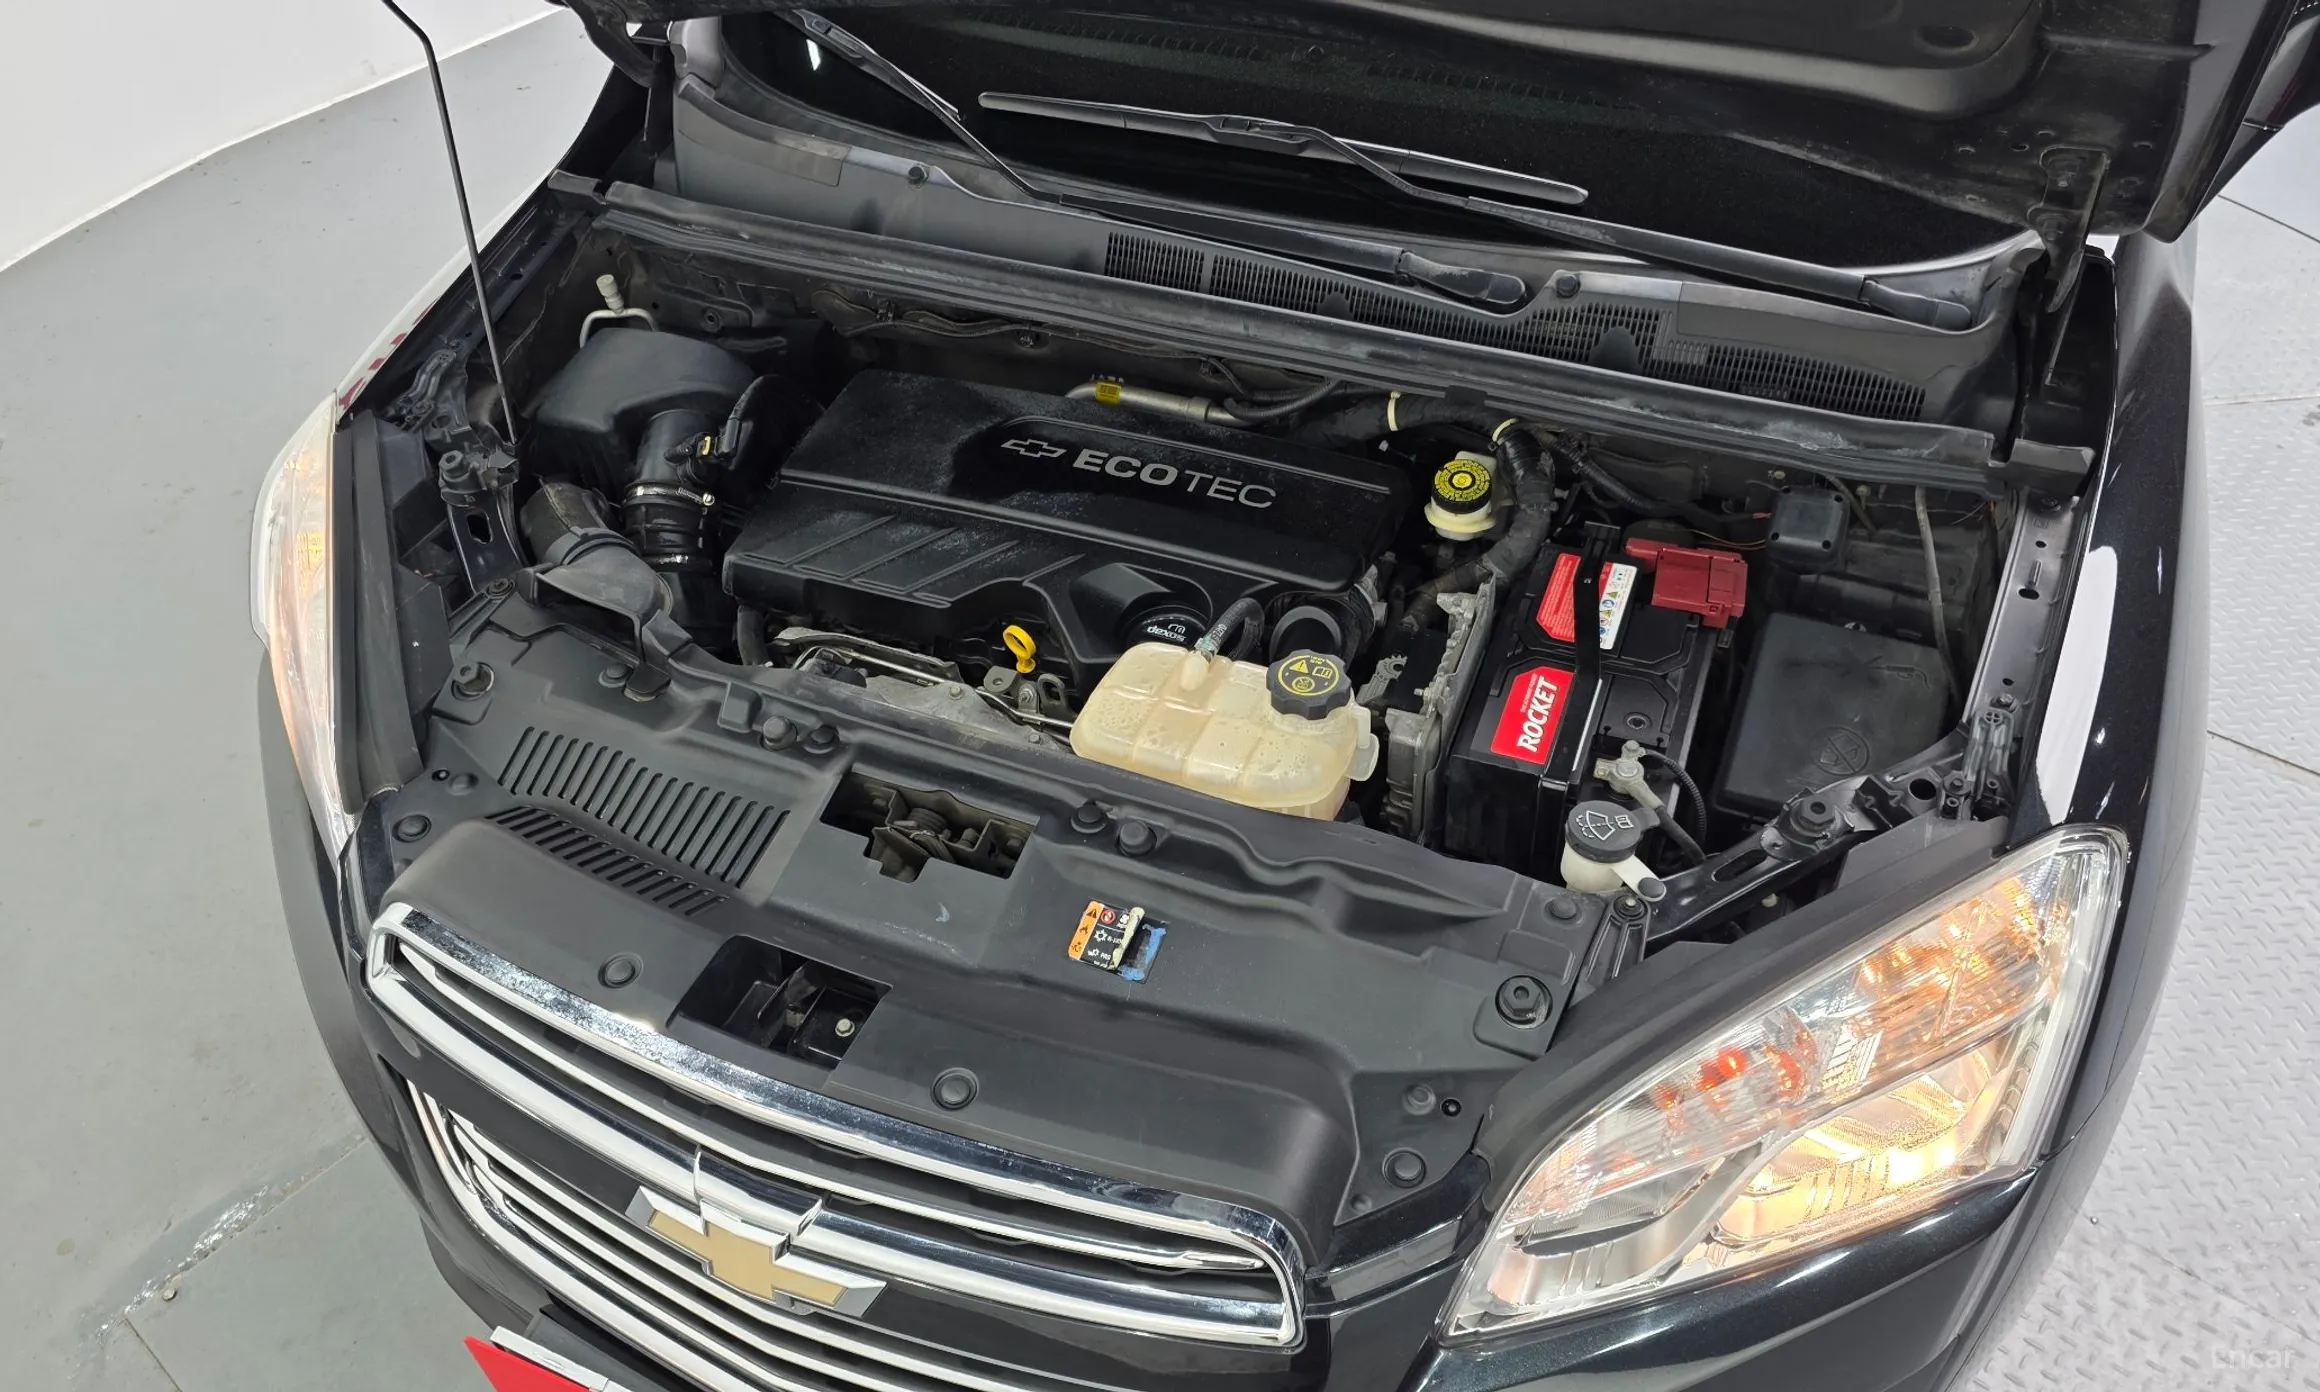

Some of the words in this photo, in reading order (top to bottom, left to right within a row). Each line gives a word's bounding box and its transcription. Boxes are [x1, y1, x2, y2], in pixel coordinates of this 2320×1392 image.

[1073, 448, 1277, 509] ECOTEC
[1146, 625, 1187, 643] dexos
[1517, 675, 1558, 753] ROCKET
